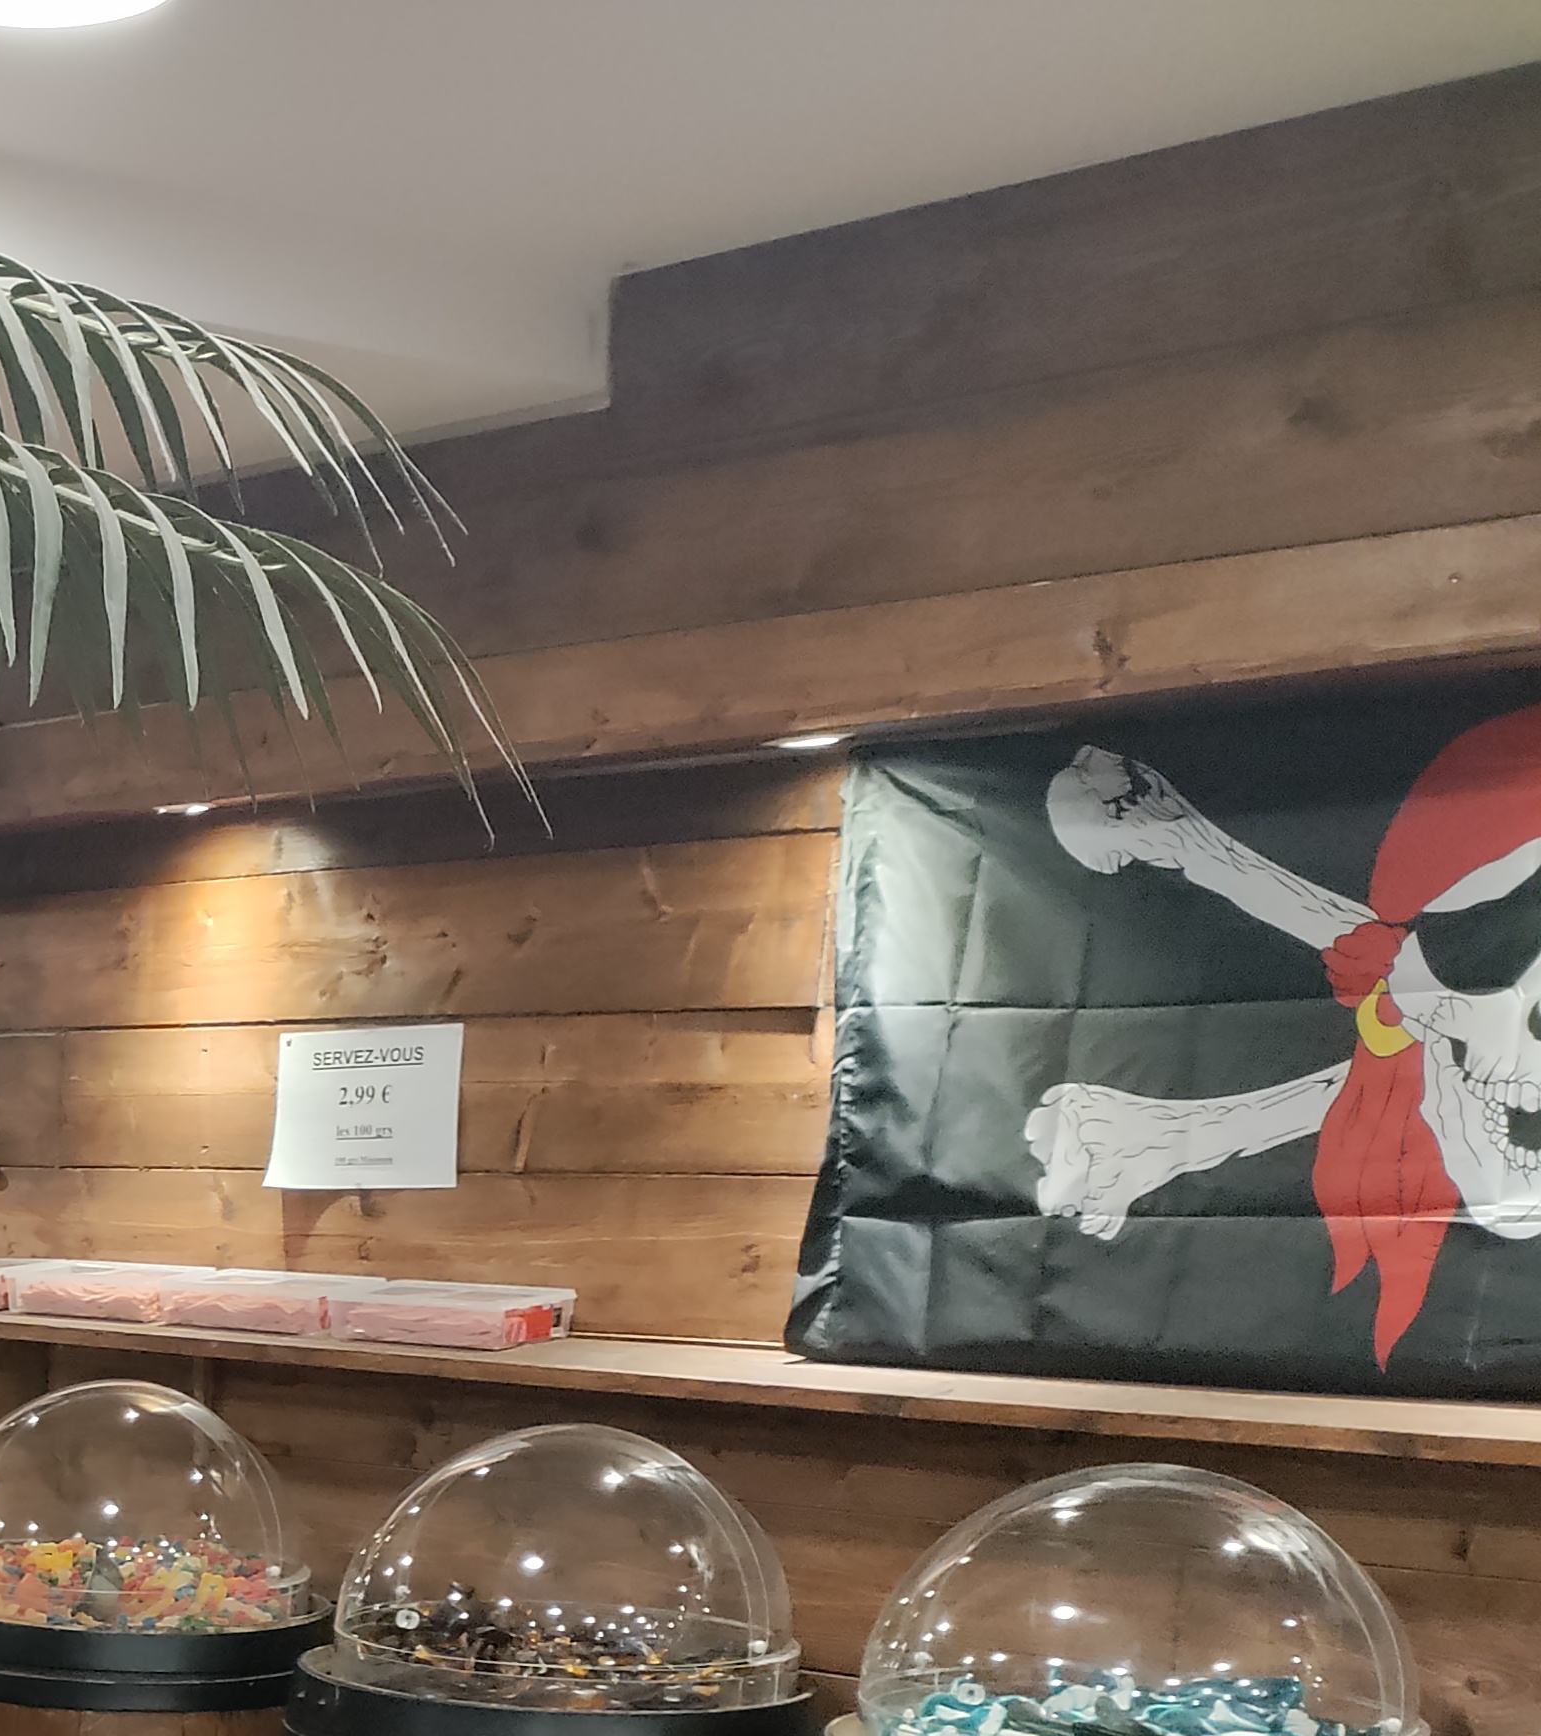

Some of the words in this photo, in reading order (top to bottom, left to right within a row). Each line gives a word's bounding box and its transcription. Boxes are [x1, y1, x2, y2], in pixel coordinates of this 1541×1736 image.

[312, 1046, 425, 1067] SERVEZ-VOUS
[339, 1086, 376, 1105] 2.99
[381, 1084, 392, 1104] €
[336, 1124, 350, 1136] les
[354, 1124, 373, 1136] 100
